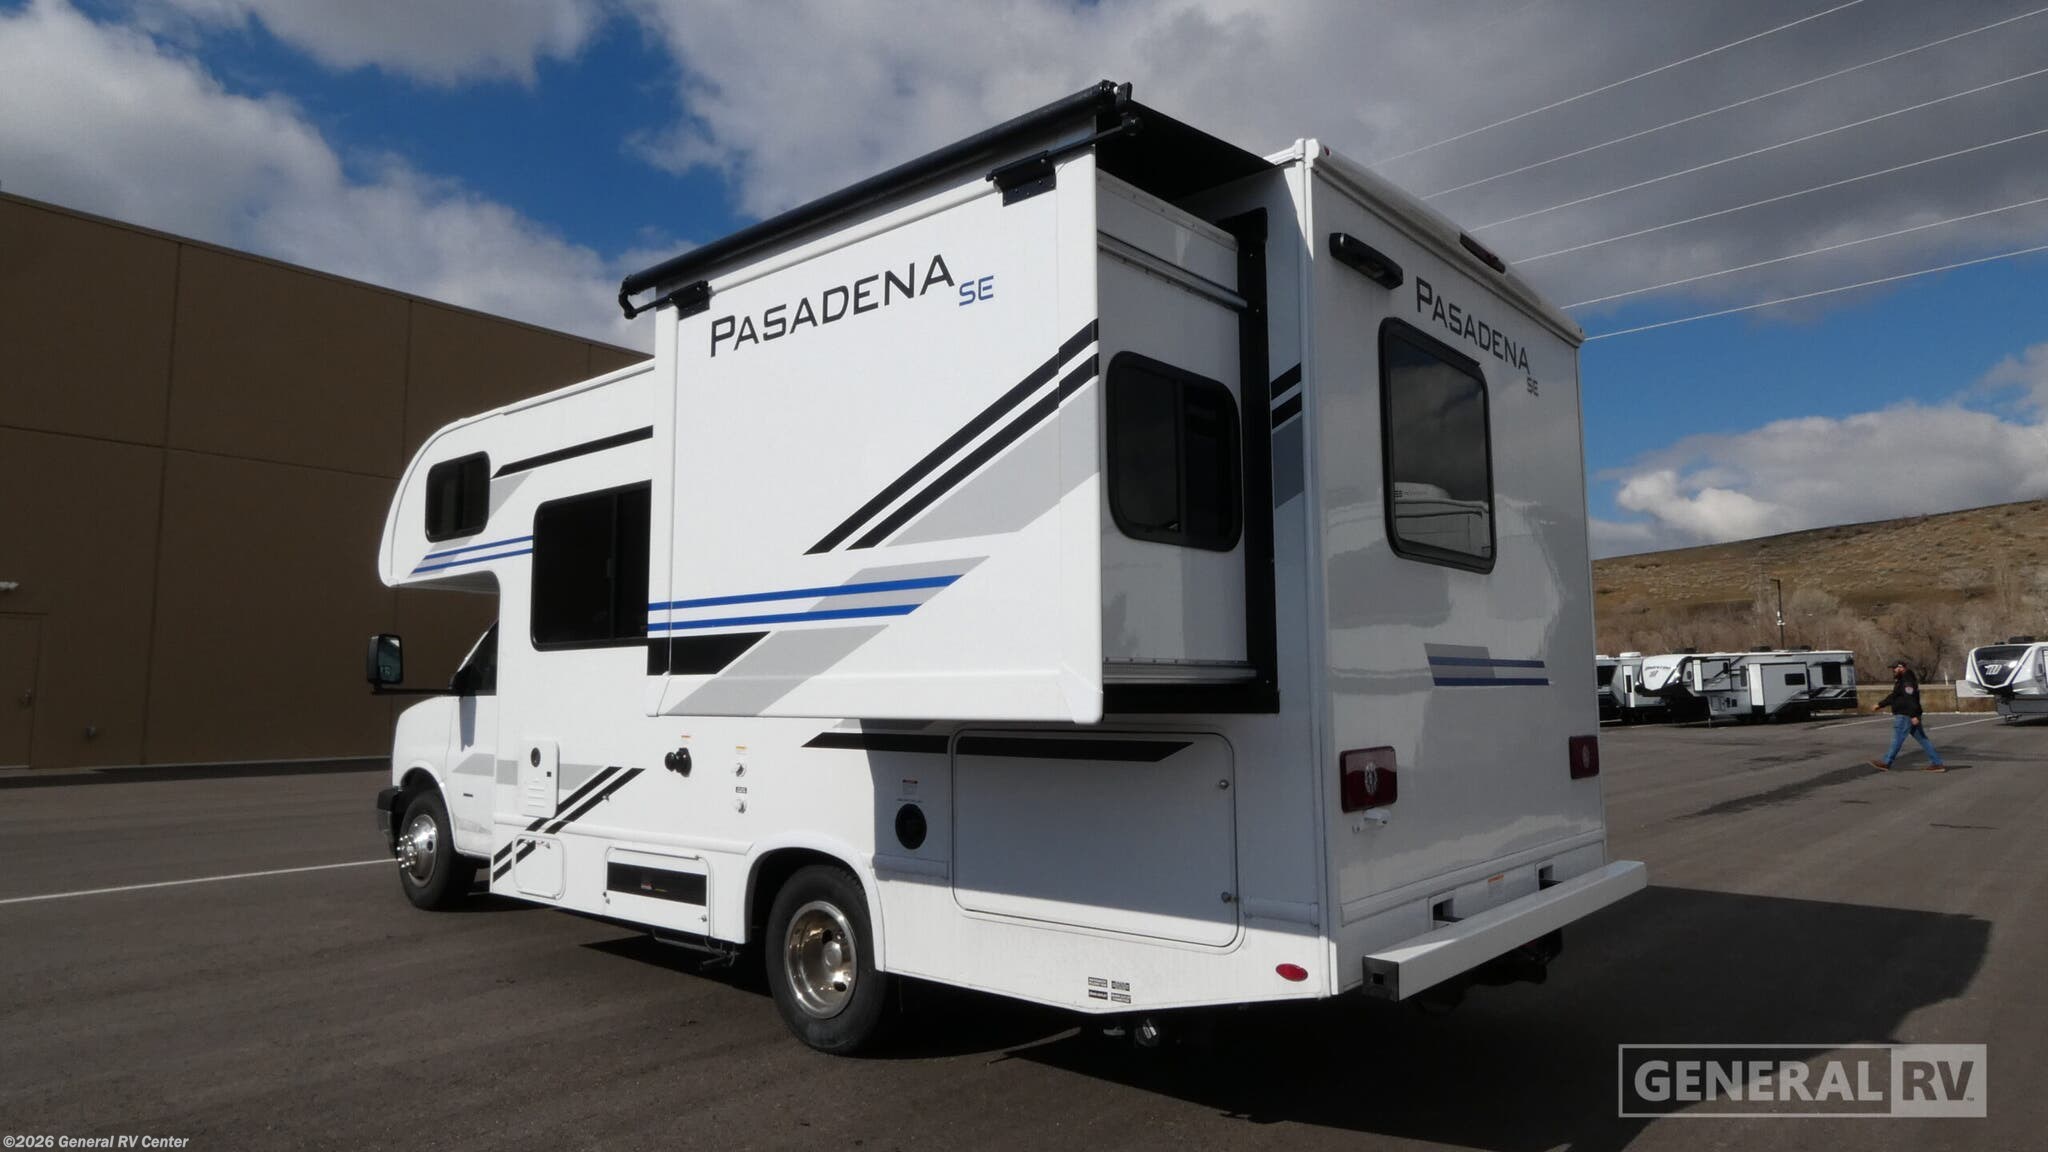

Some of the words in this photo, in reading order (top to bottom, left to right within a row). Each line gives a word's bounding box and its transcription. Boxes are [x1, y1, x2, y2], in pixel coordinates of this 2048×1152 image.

[710, 254, 955, 358] PASADENA
[958, 275, 994, 307] SE
[1416, 276, 1531, 375] PASADENA
[1526, 377, 1539, 397] SE
